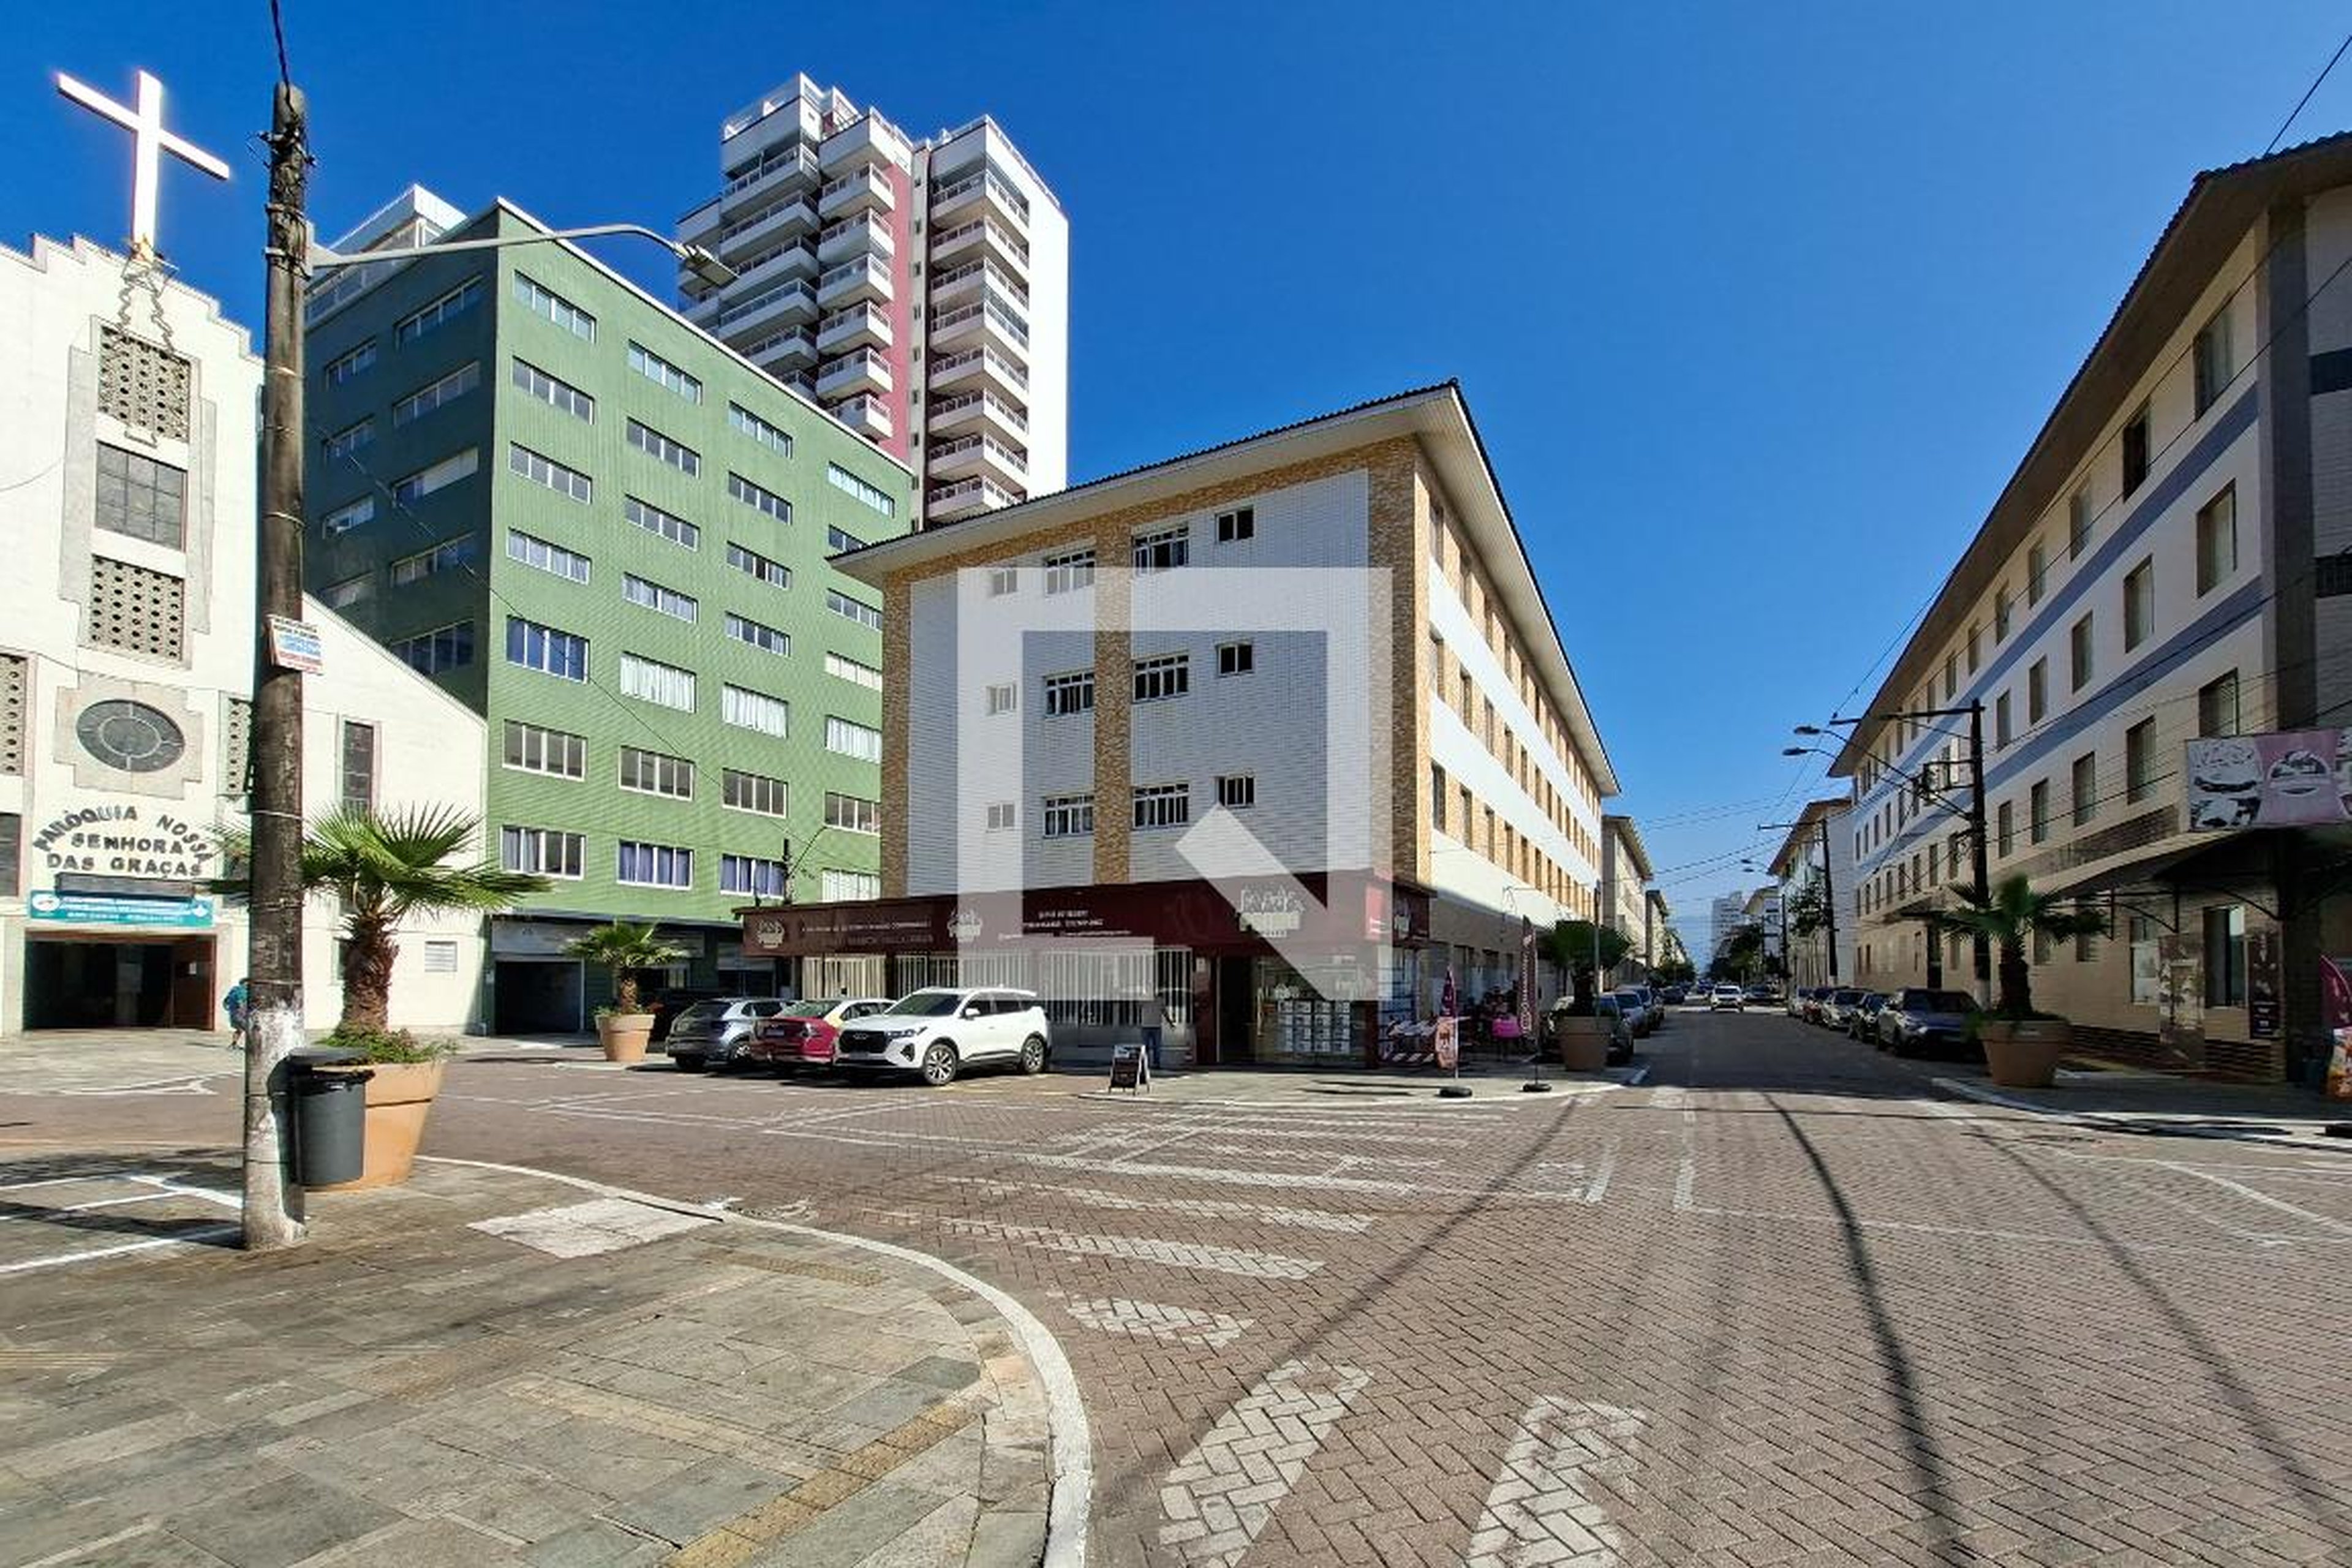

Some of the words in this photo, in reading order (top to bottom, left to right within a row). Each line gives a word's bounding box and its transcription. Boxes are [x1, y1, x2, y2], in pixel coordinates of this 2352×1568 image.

[71, 832, 183, 854] SENHORA
[156, 815, 213, 864] NOSSA
[47, 853, 94, 870] DAS
[110, 857, 202, 878] GRAÇAS
